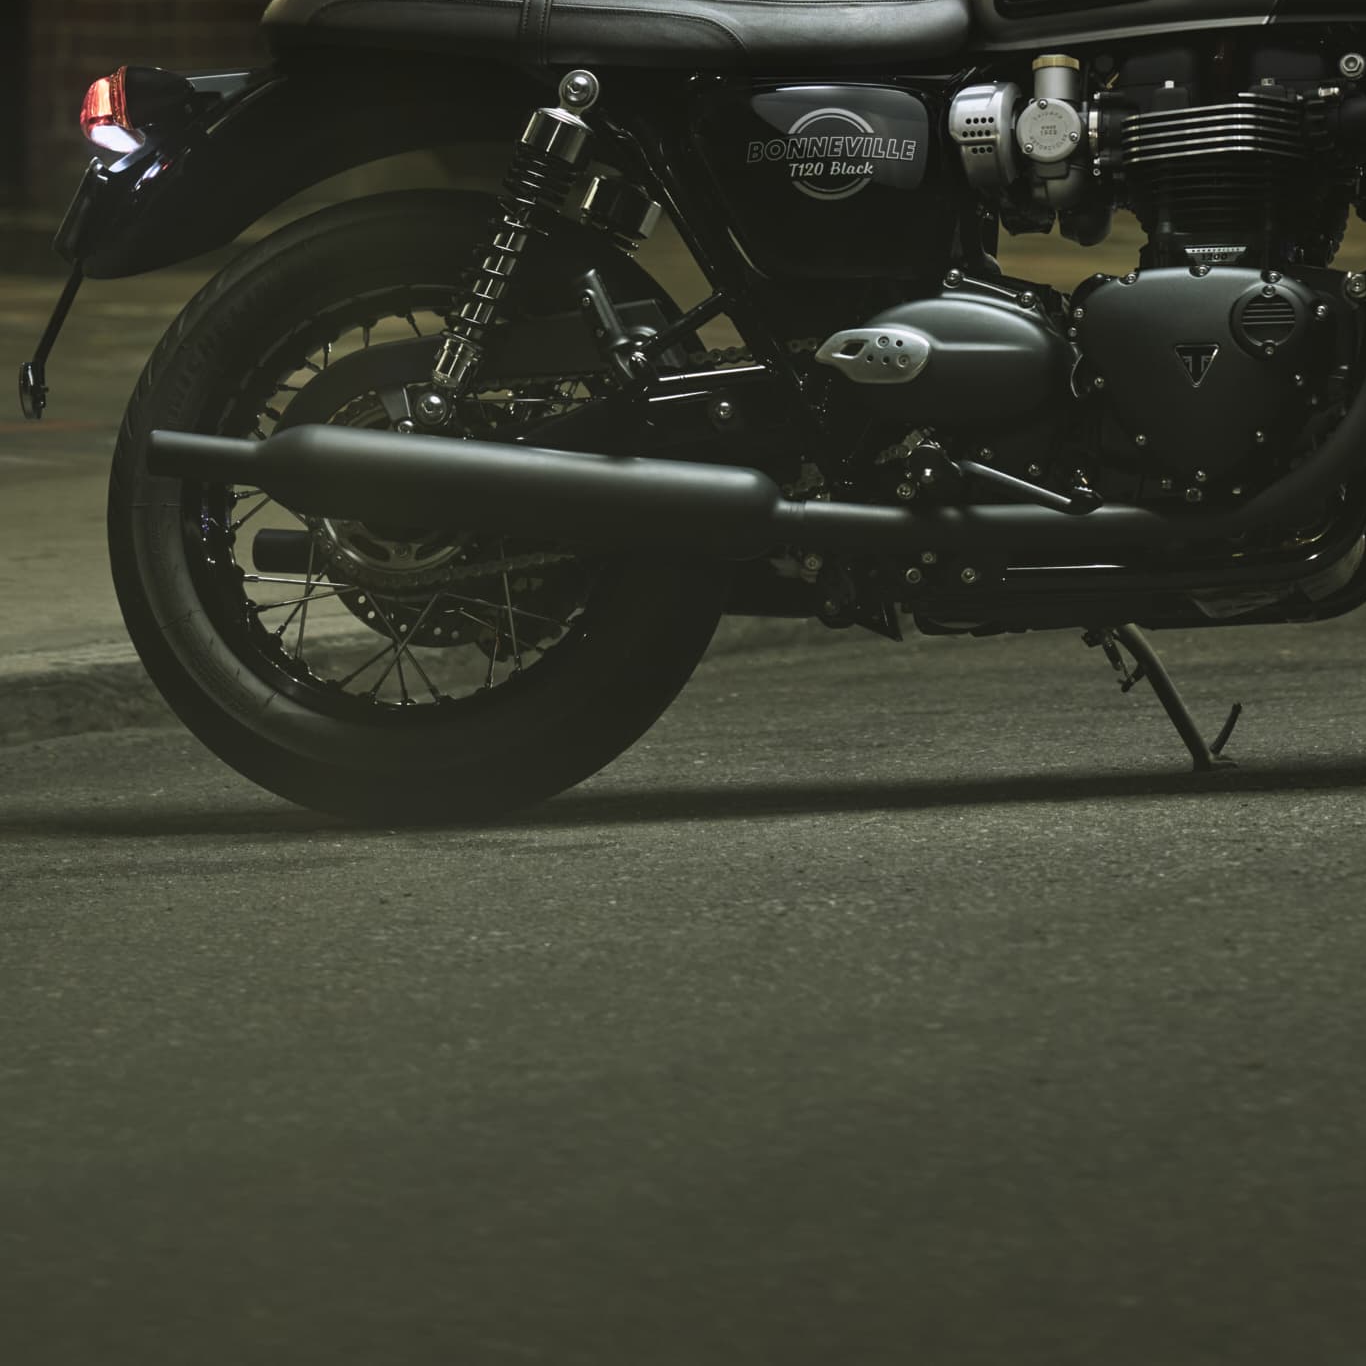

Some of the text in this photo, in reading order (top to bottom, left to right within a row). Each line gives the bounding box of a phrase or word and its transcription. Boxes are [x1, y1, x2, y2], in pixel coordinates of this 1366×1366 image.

[747, 136, 917, 162] BONNEVILLE
[789, 161, 874, 177] T120 Black
